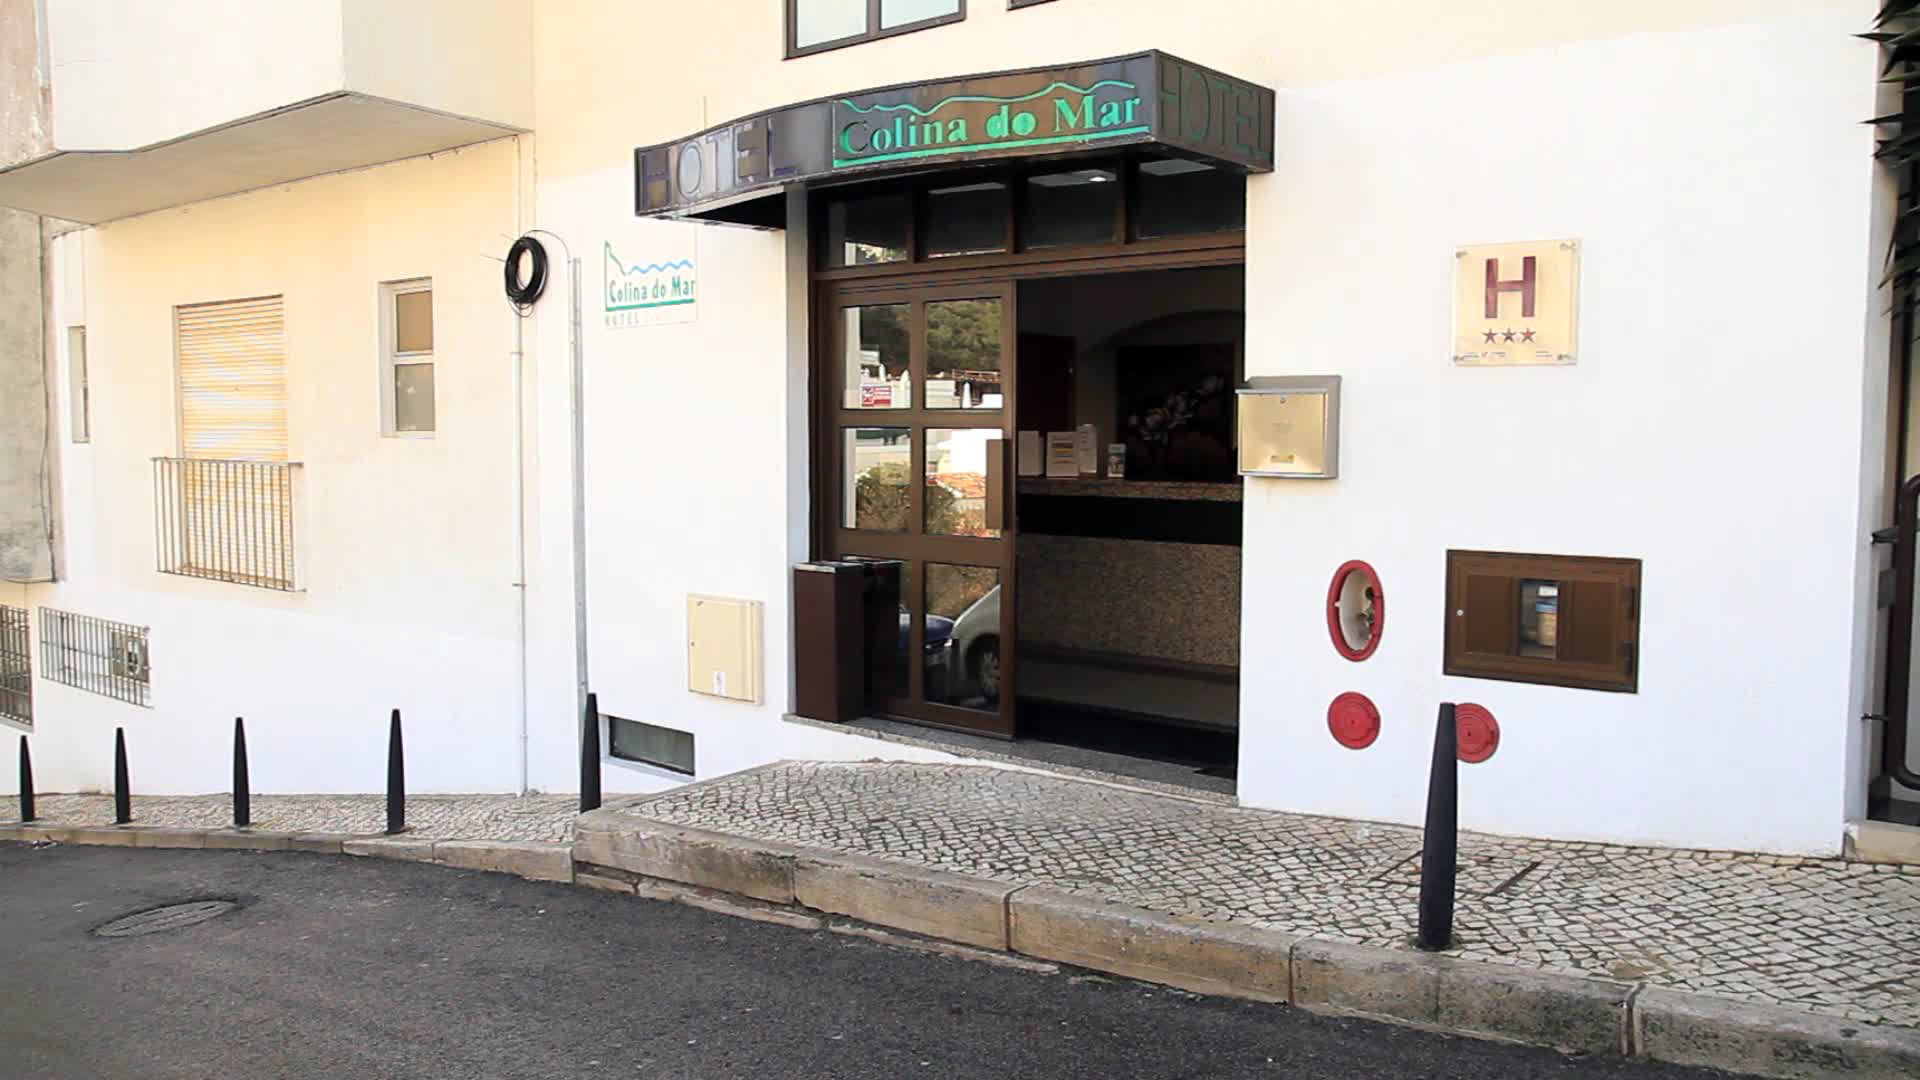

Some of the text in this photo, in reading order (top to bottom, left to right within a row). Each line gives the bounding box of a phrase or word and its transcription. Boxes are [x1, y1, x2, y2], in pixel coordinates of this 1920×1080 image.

[840, 94, 1142, 154] Colina do Mar
[1157, 60, 1272, 161] HOTEL
[638, 115, 800, 208] HOTEL
[609, 275, 696, 303] Colina do Mar
[1485, 256, 1536, 319] H
